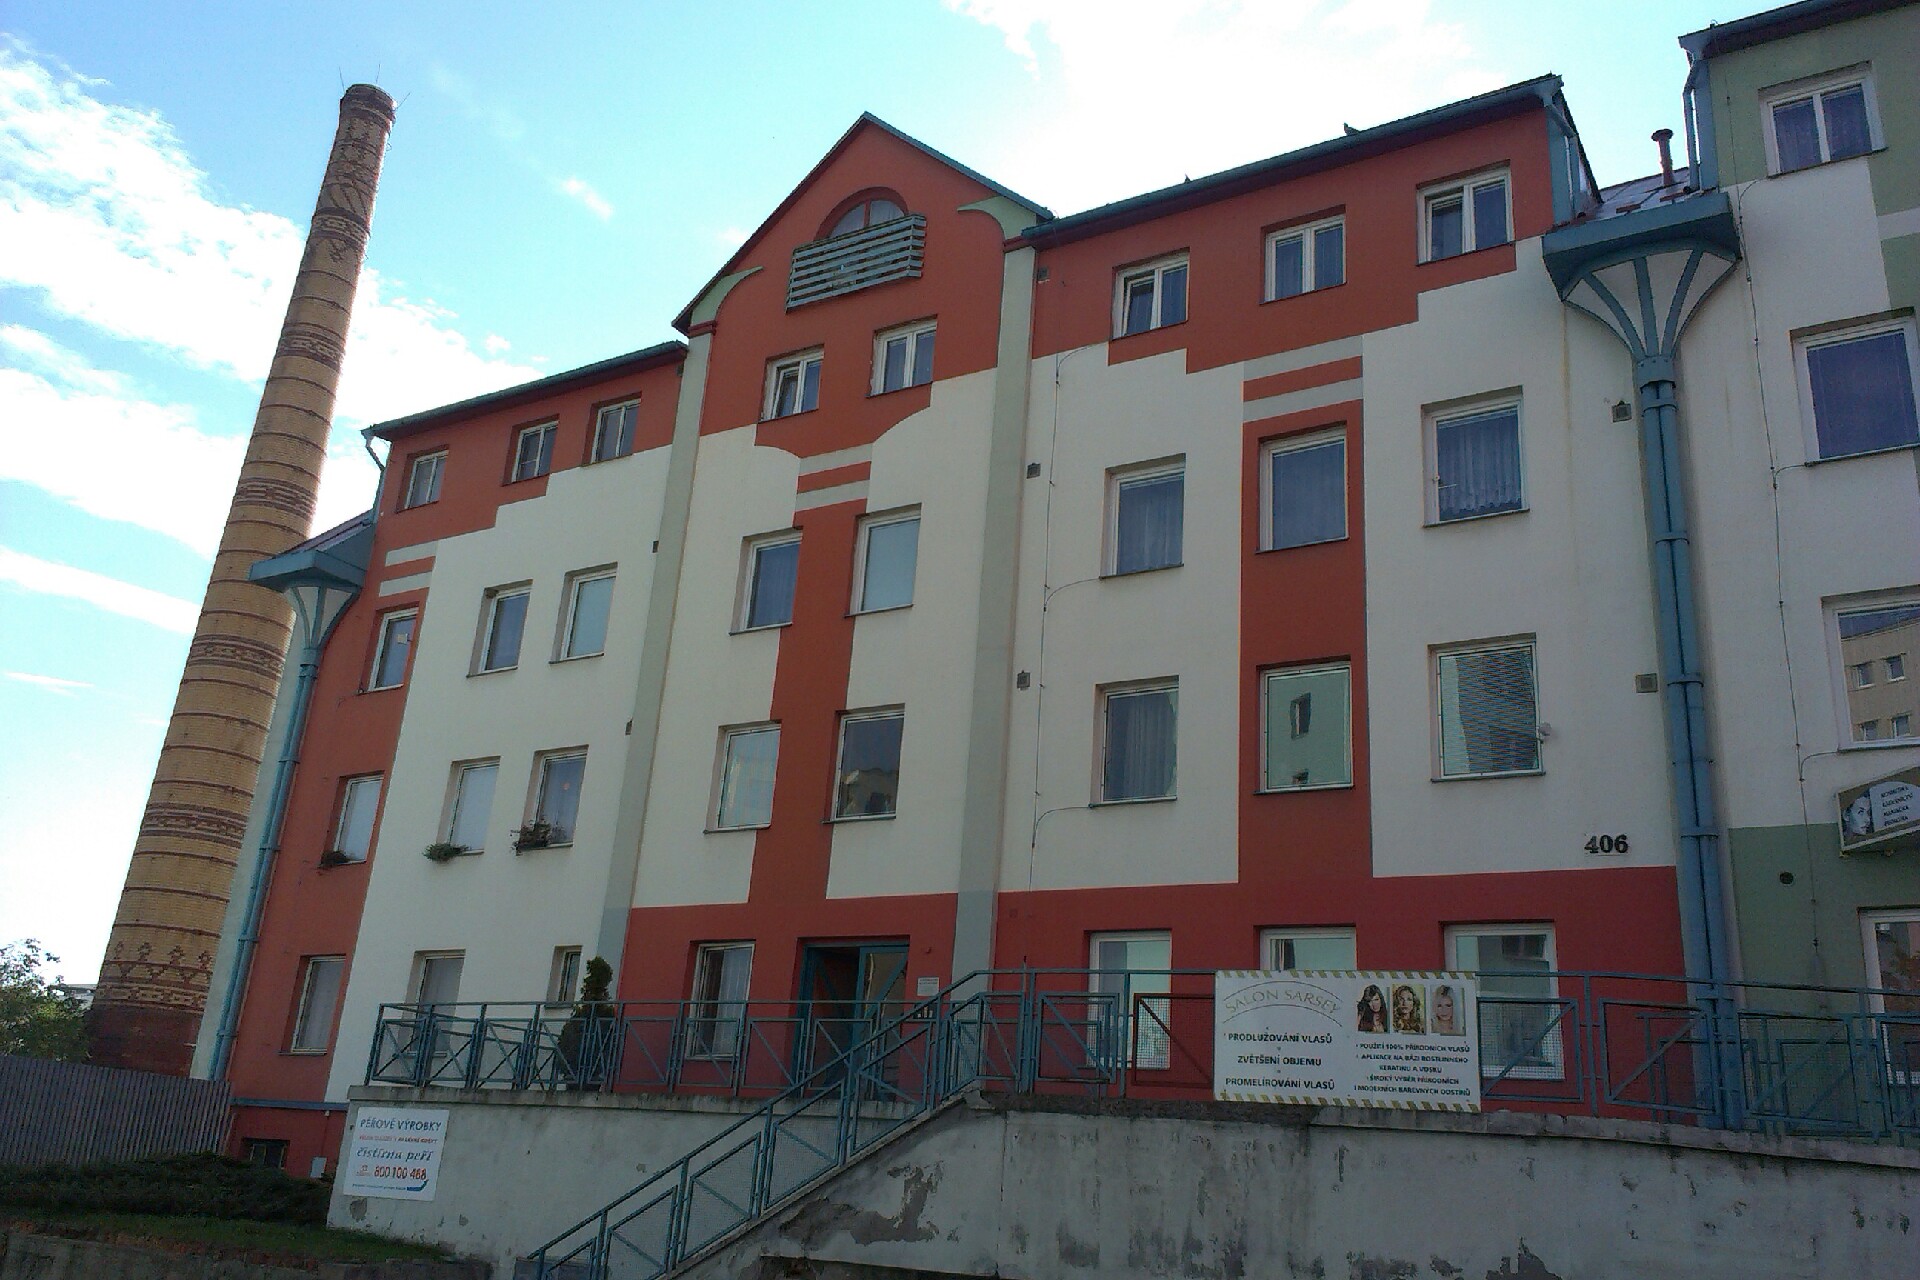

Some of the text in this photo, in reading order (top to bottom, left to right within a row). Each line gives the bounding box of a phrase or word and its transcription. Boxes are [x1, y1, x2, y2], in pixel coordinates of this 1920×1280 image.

[1584, 834, 1628, 854] 406
[1225, 989, 1279, 1013] SALON
[1228, 1032, 1332, 1044] PRODLUŽOVÁNÍ VLASŮ
[1237, 1053, 1322, 1067] ZVĚTŠENÍ OBJEMU
[1225, 1076, 1335, 1091] PROMELÍROVÁNÍ VLASŮ
[360, 1117, 442, 1132] PÉŘOVÉ VÝROBKY
[392, 1166, 408, 1179] 100
[409, 1168, 427, 1181] 468
